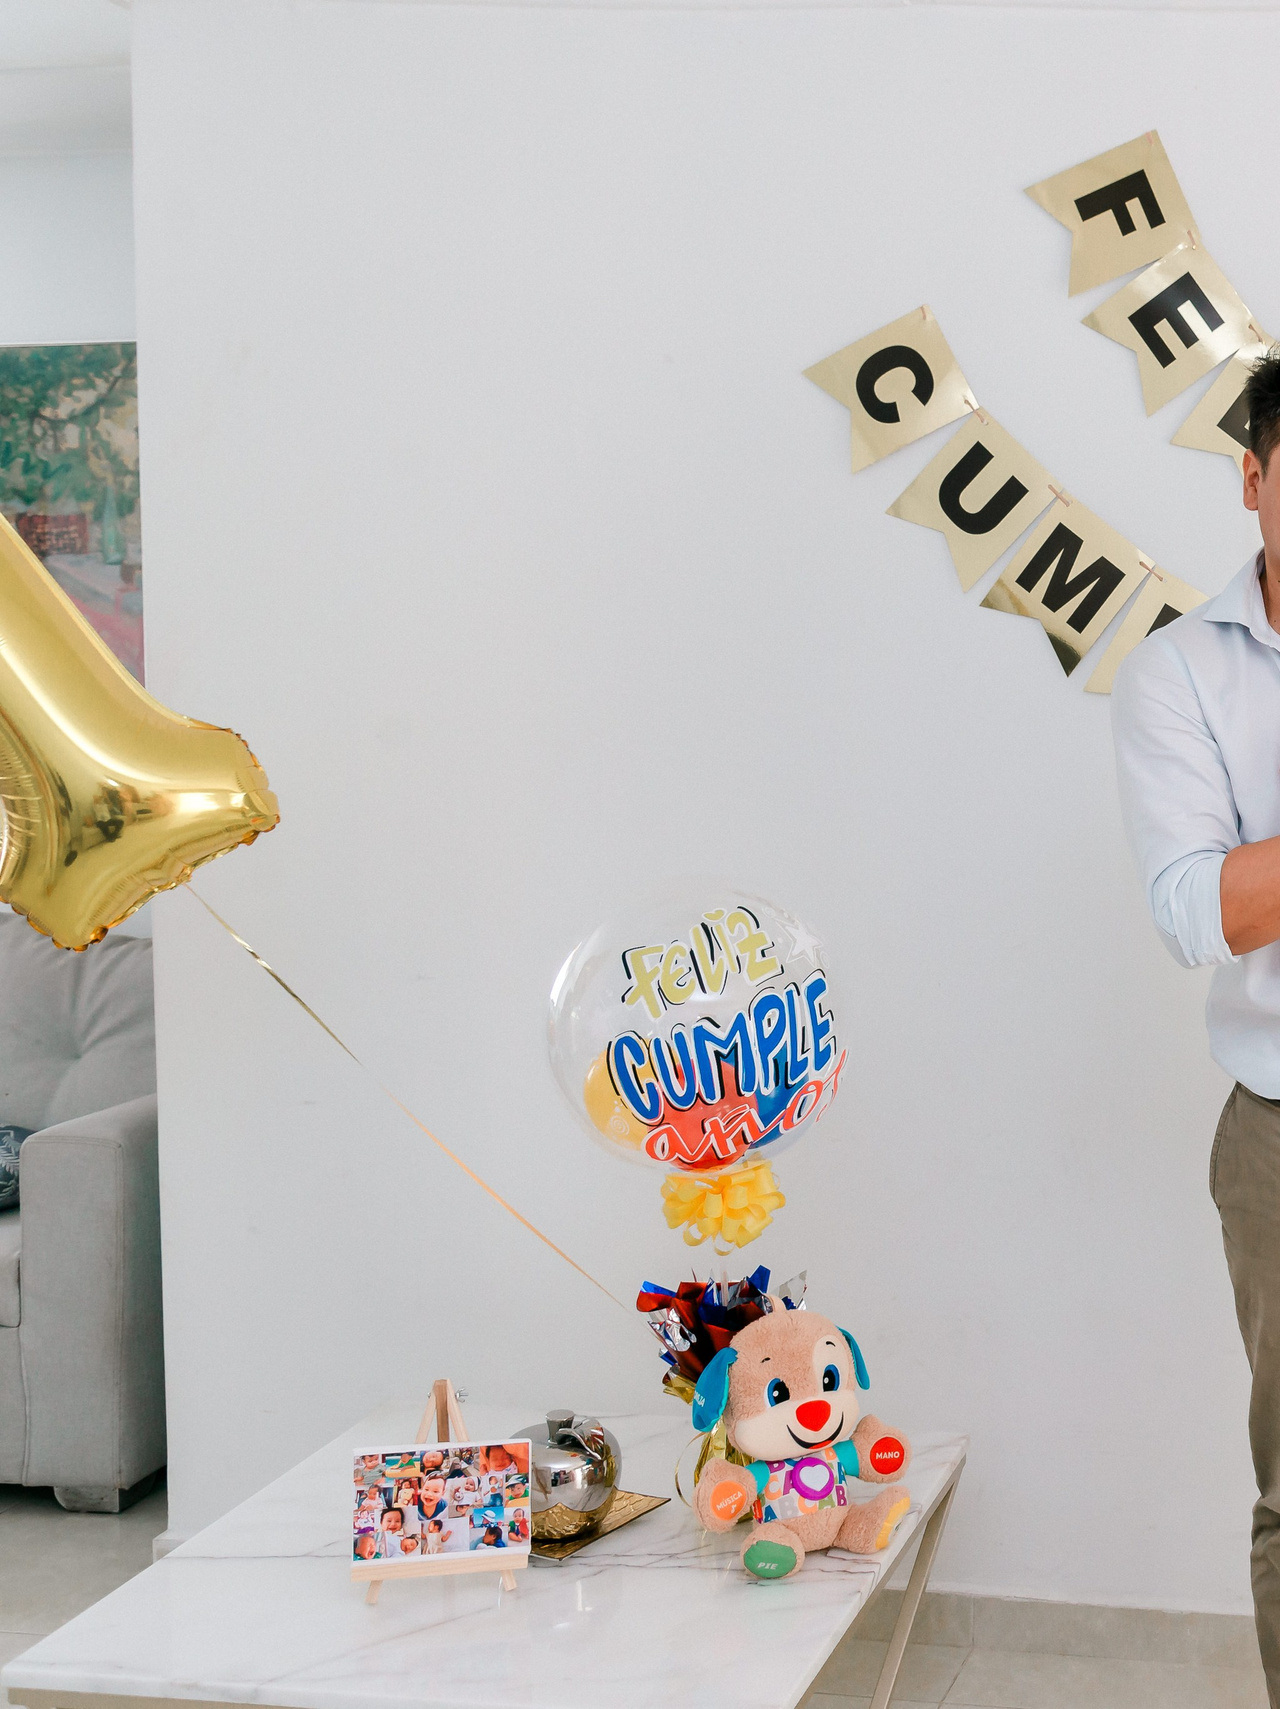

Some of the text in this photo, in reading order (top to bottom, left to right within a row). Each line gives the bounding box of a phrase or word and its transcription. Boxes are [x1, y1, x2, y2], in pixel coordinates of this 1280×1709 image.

[855, 344, 1184, 638] CUM
[622, 906, 784, 1020] FELIZ
[607, 969, 836, 1123] CUMPLE
[876, 1451, 900, 1460] MANO
